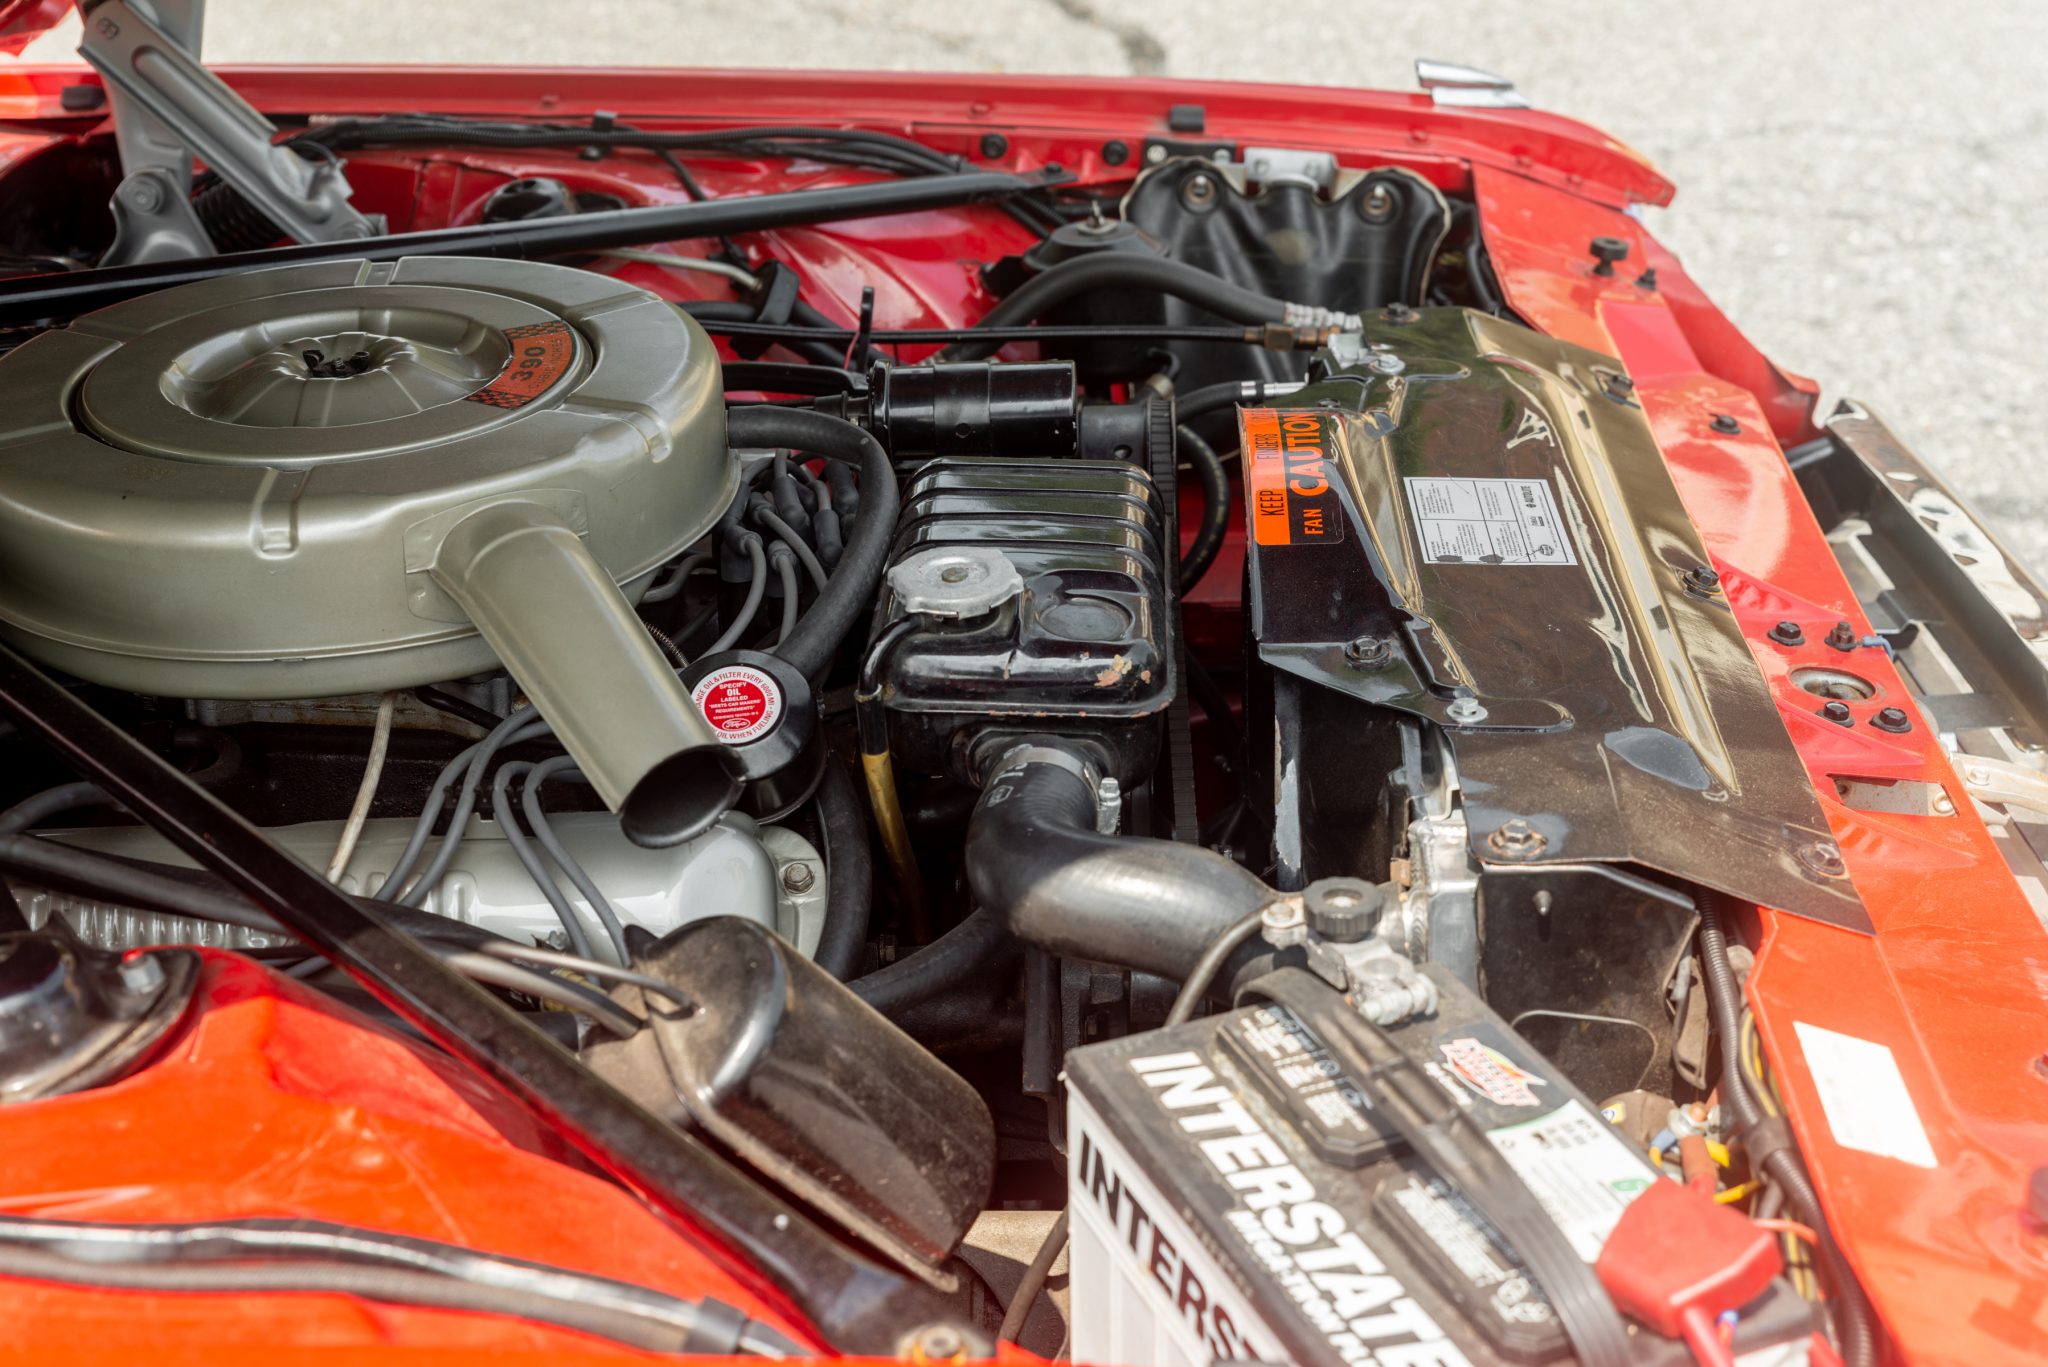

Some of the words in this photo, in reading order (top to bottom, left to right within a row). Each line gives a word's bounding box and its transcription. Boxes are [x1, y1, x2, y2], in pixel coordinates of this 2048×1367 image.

[510, 346, 546, 381] 390
[1255, 433, 1279, 459] FINGERS
[1282, 413, 1329, 496] CAUTION
[1260, 490, 1285, 516] KEEP
[1303, 508, 1324, 534] FAN
[696, 689, 706, 711] HANGE
[743, 672, 763, 685] EVERY
[719, 681, 747, 690] SPECIFY
[726, 688, 741, 697] OIL
[717, 730, 727, 739] OIL
[729, 730, 752, 739] WHEN
[752, 710, 774, 733] FUELING
[1129, 1051, 1474, 1367] INTERSTATE
[1226, 1210, 1348, 1334] MEGA-TRON
